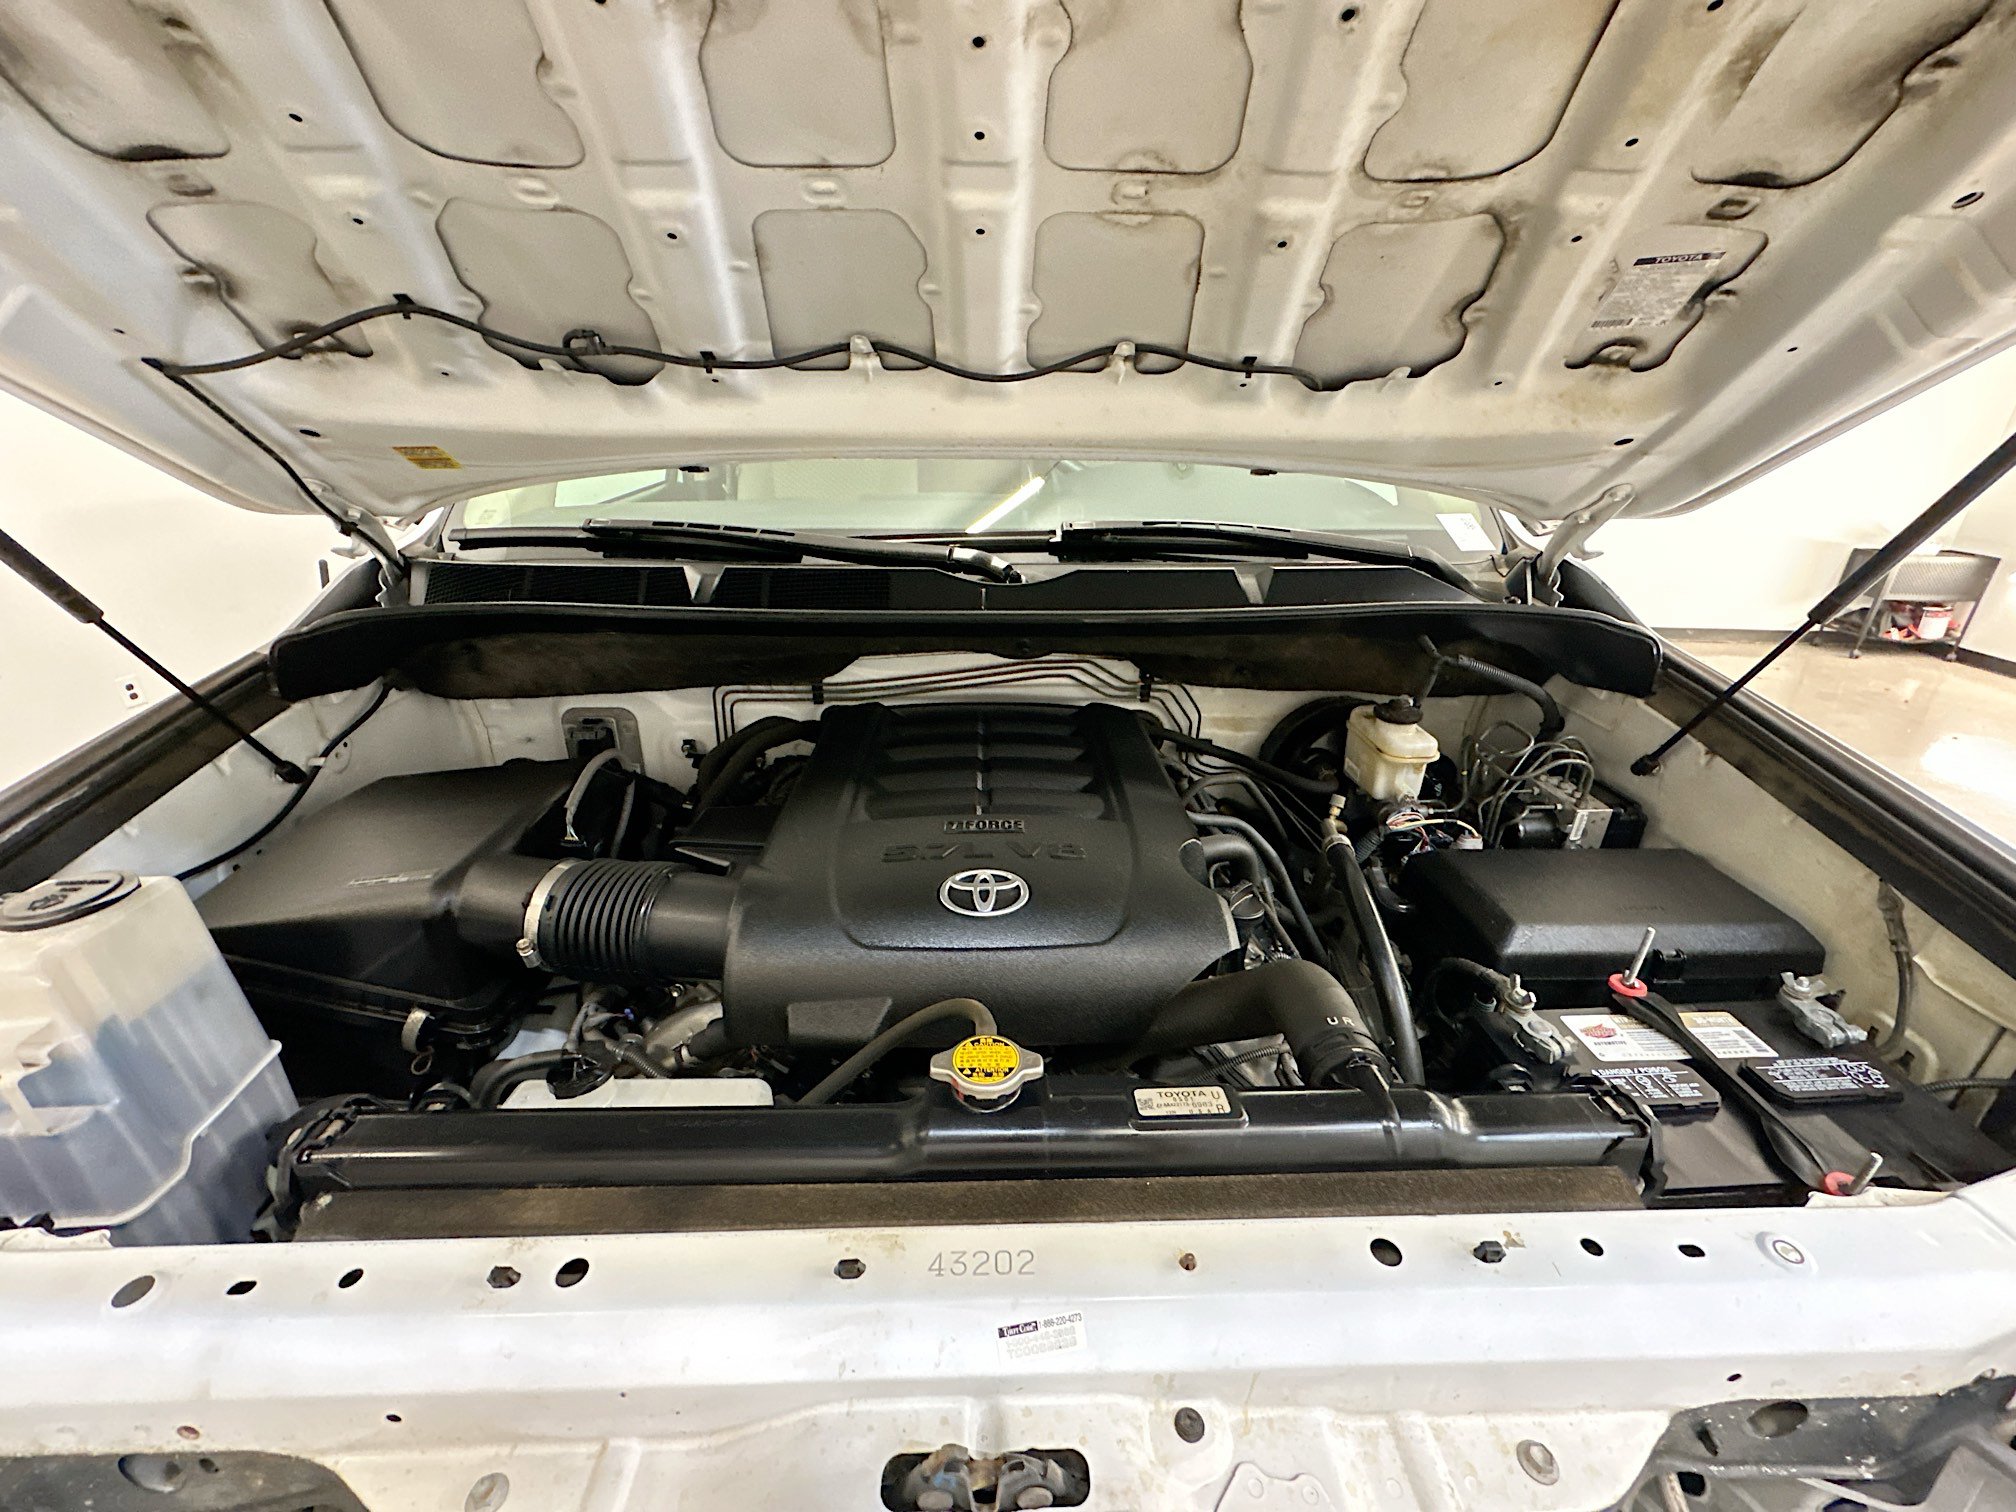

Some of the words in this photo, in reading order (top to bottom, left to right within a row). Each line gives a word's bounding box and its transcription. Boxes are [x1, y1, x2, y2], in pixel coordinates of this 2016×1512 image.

[1655, 253, 1704, 264] TOYOTA
[1598, 1068, 1633, 1076] DANGER
[1638, 1066, 1671, 1075] POISON
[1156, 1090, 1207, 1099] TOYOTA
[927, 1249, 1036, 1277] 43202
